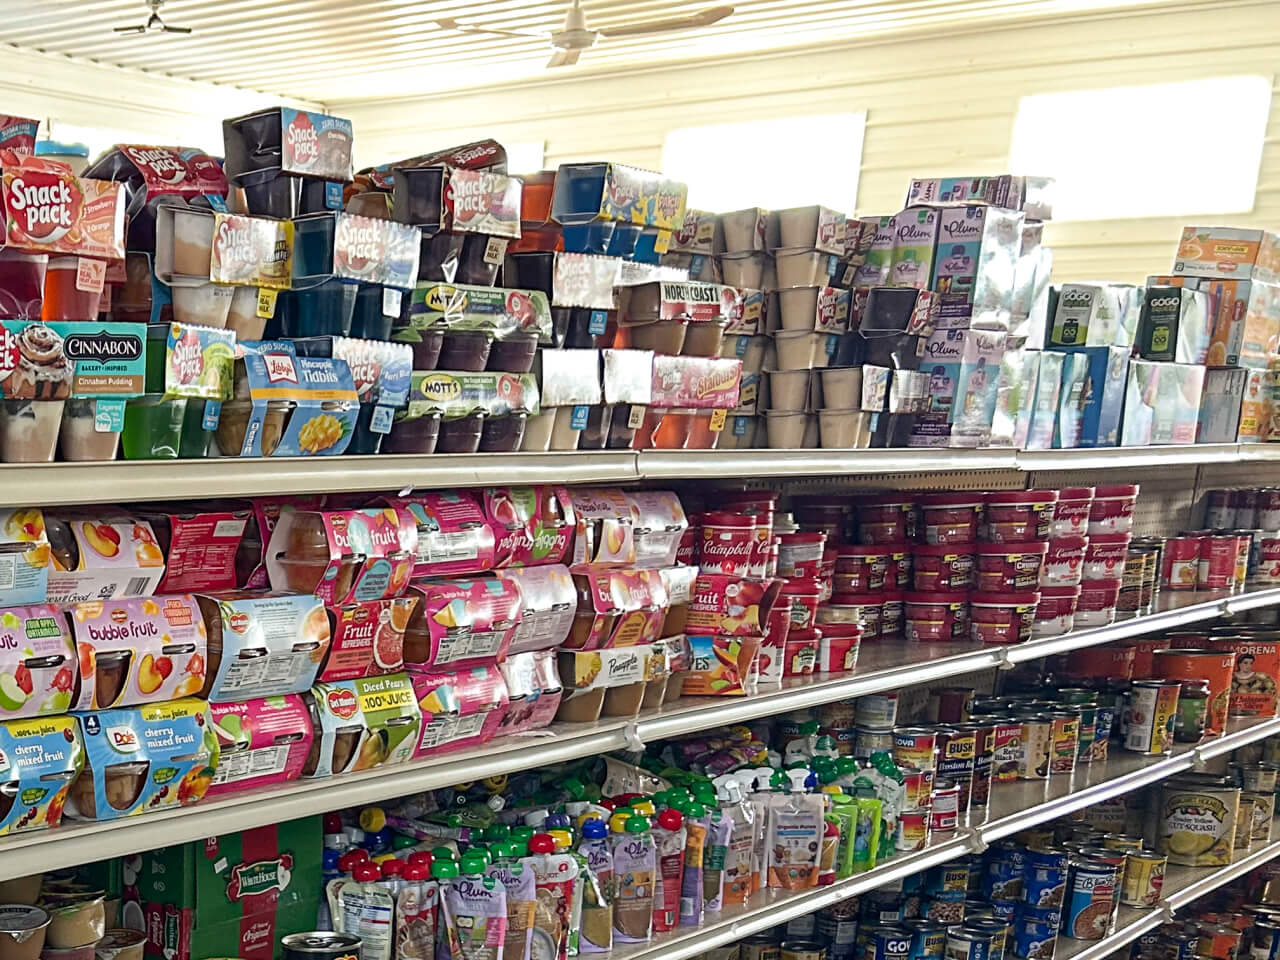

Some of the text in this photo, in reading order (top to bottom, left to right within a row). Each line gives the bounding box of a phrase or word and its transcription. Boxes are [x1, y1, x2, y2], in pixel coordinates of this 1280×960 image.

[288, 123, 318, 145] Snack
[128, 148, 173, 166] Snack
[294, 140, 318, 159] pack
[148, 157, 181, 172] pack
[11, 179, 72, 210] Snack
[455, 190, 488, 213] pack
[25, 204, 71, 230] pack
[339, 220, 381, 243] Snack
[897, 222, 932, 238] Plum
[943, 219, 980, 235] Plum
[348, 240, 379, 263] pack
[1150, 297, 1179, 307] GOGO
[68, 339, 137, 355] CINNABON
[173, 341, 202, 363] Snack
[928, 341, 960, 358] Plum
[181, 361, 201, 380] pack
[271, 359, 292, 375] Libby's
[107, 377, 132, 387] Pudding
[302, 369, 338, 383] Tidbits
[424, 380, 461, 394] MOTT'S
[371, 531, 398, 544] fruit
[88, 622, 158, 641] bubble fruit
[343, 623, 372, 638] Fruit
[363, 679, 404, 693] Diced Pears
[366, 692, 412, 708] 100% JUICE
[87, 716, 96, 728] 4
[171, 709, 188, 720] juice
[113, 731, 135, 746] Dole
[144, 726, 174, 739] cherry
[147, 733, 195, 748] mixed fruit
[15, 744, 43, 758] cherry
[17, 751, 64, 767] mixed fruit
[453, 884, 493, 902] Plum
